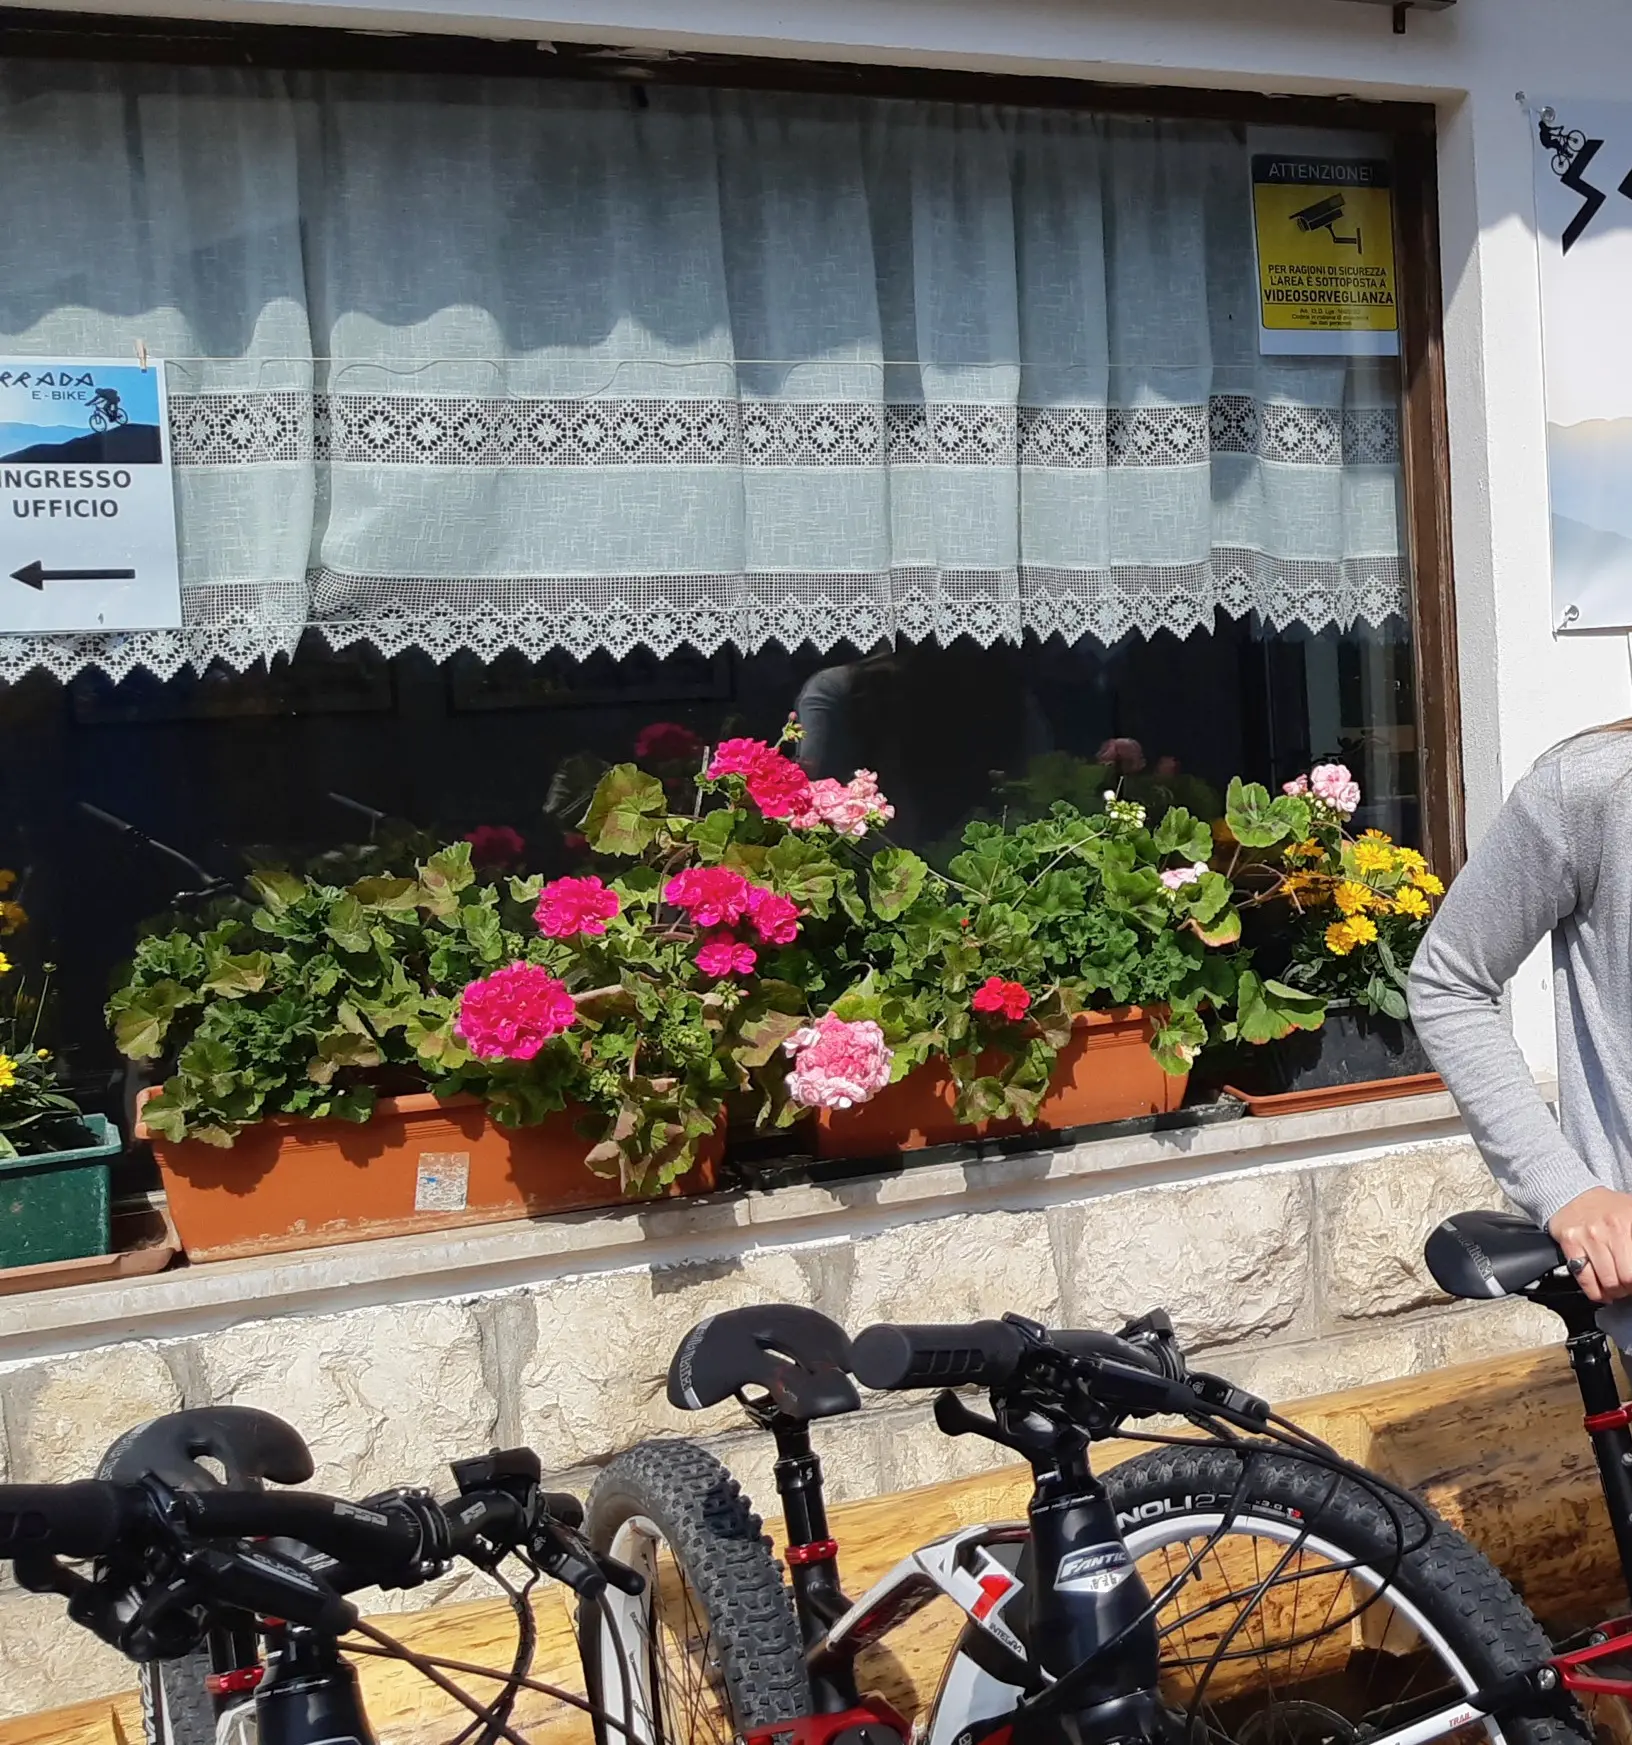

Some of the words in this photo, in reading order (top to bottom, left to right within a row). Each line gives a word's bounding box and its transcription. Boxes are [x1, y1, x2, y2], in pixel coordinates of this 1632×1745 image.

[1268, 162, 1374, 181] ATTENZIONE!
[1268, 264, 1287, 274] PER
[1289, 265, 1326, 275] RAGIONI
[1327, 266, 1337, 276] DI
[1338, 266, 1387, 277] SICUREZZA
[1270, 275, 1304, 287] L'AREA
[1315, 276, 1378, 288] SOTTOPOSTA
[1379, 278, 1387, 288] A
[1264, 289, 1394, 304] VIDEOSORVEGLIANZA
[13, 499, 119, 518] UFFICIO
[1060, 1551, 1128, 1579] FANTIC
[988, 1621, 1023, 1654] INTEGRA
